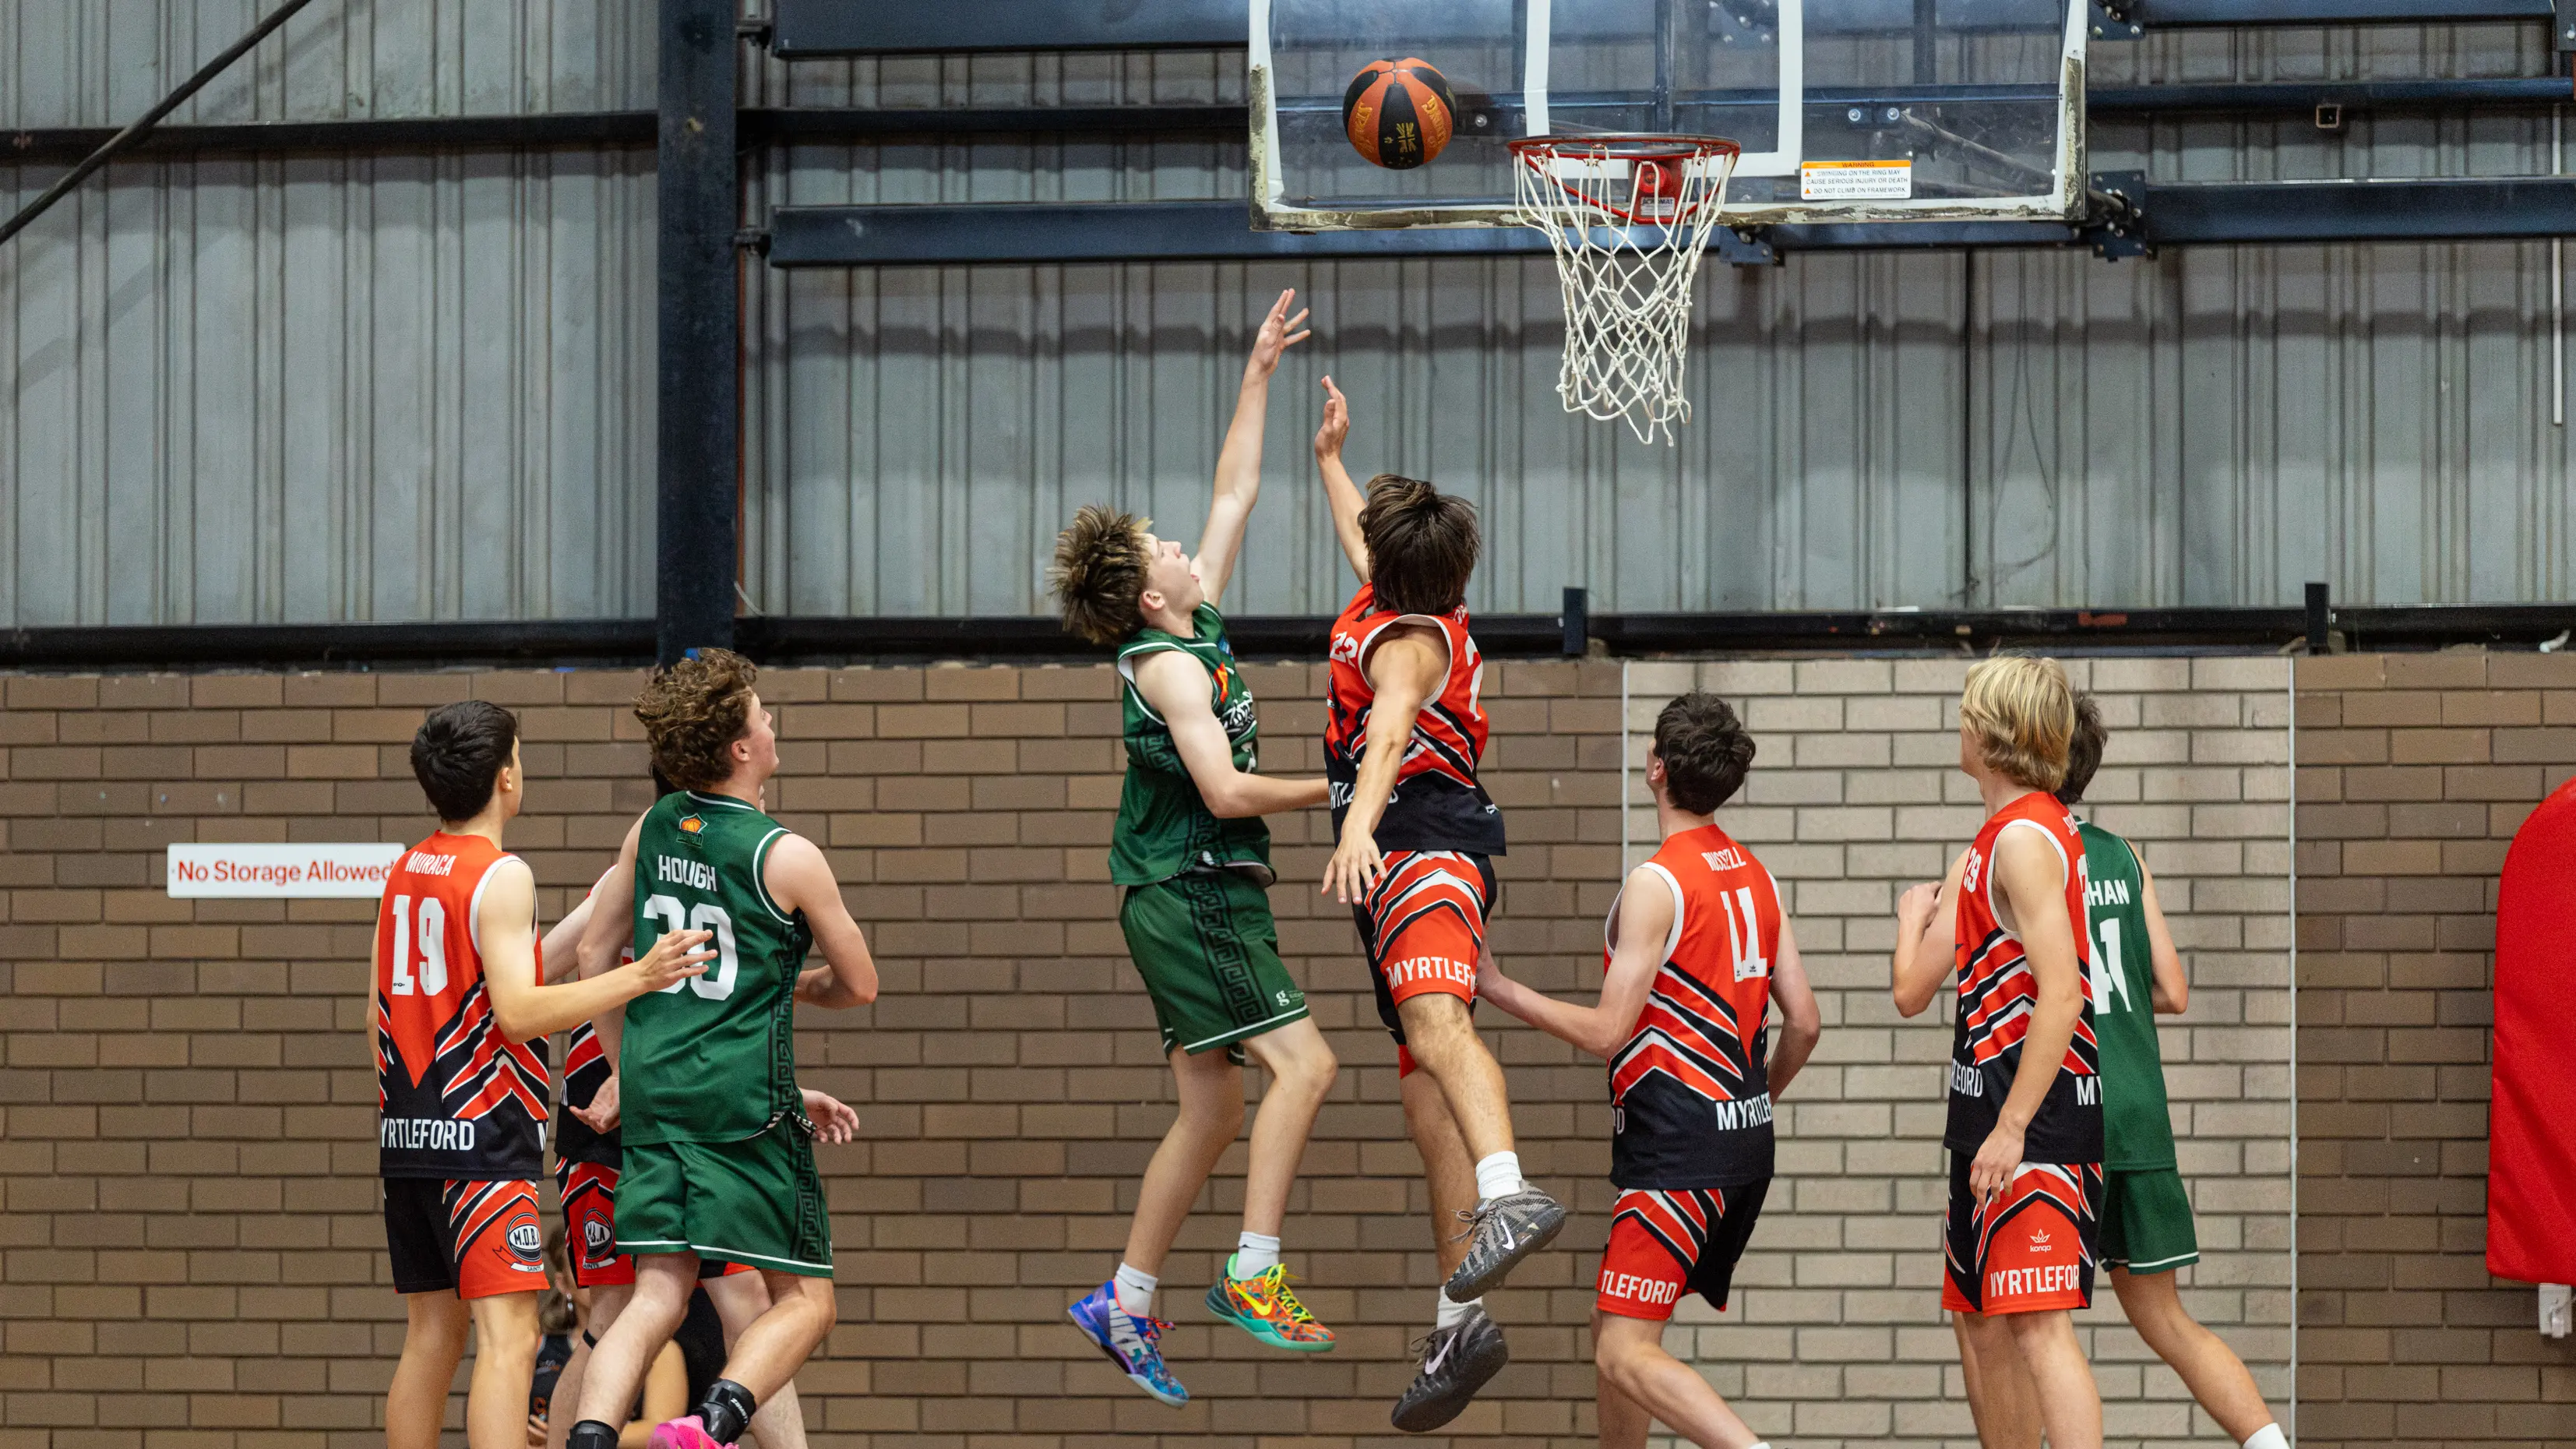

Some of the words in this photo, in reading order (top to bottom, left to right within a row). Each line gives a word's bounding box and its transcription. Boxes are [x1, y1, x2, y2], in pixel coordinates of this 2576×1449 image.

[178, 860, 209, 882] No
[213, 860, 301, 887] Storage
[405, 851, 457, 876] MURACA
[658, 855, 717, 891] HOUGH
[2088, 880, 2130, 907] HAN
[391, 894, 448, 996] 19
[643, 894, 738, 1001] 30
[1720, 886, 1767, 982] 11
